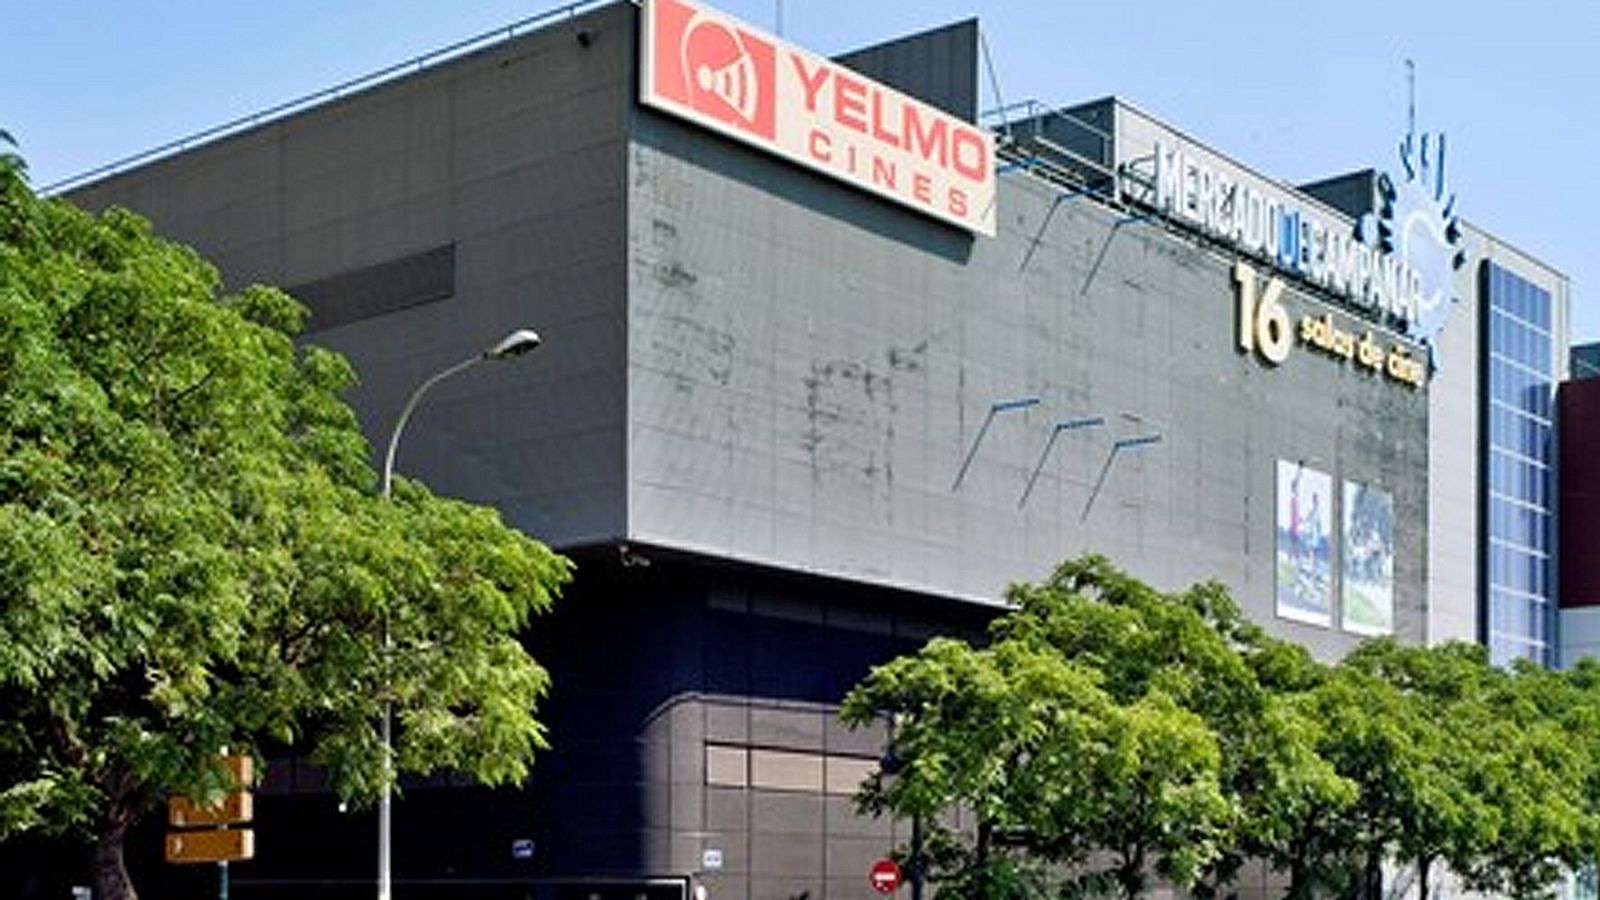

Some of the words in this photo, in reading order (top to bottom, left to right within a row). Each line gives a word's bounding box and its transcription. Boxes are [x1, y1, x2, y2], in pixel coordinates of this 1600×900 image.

[791, 53, 988, 183] YELMO
[808, 128, 968, 219] CINES
[1156, 141, 1278, 258] MERCADO
[1234, 262, 1292, 363] 16
[1301, 313, 1353, 360] salas
[1358, 330, 1384, 371] de
